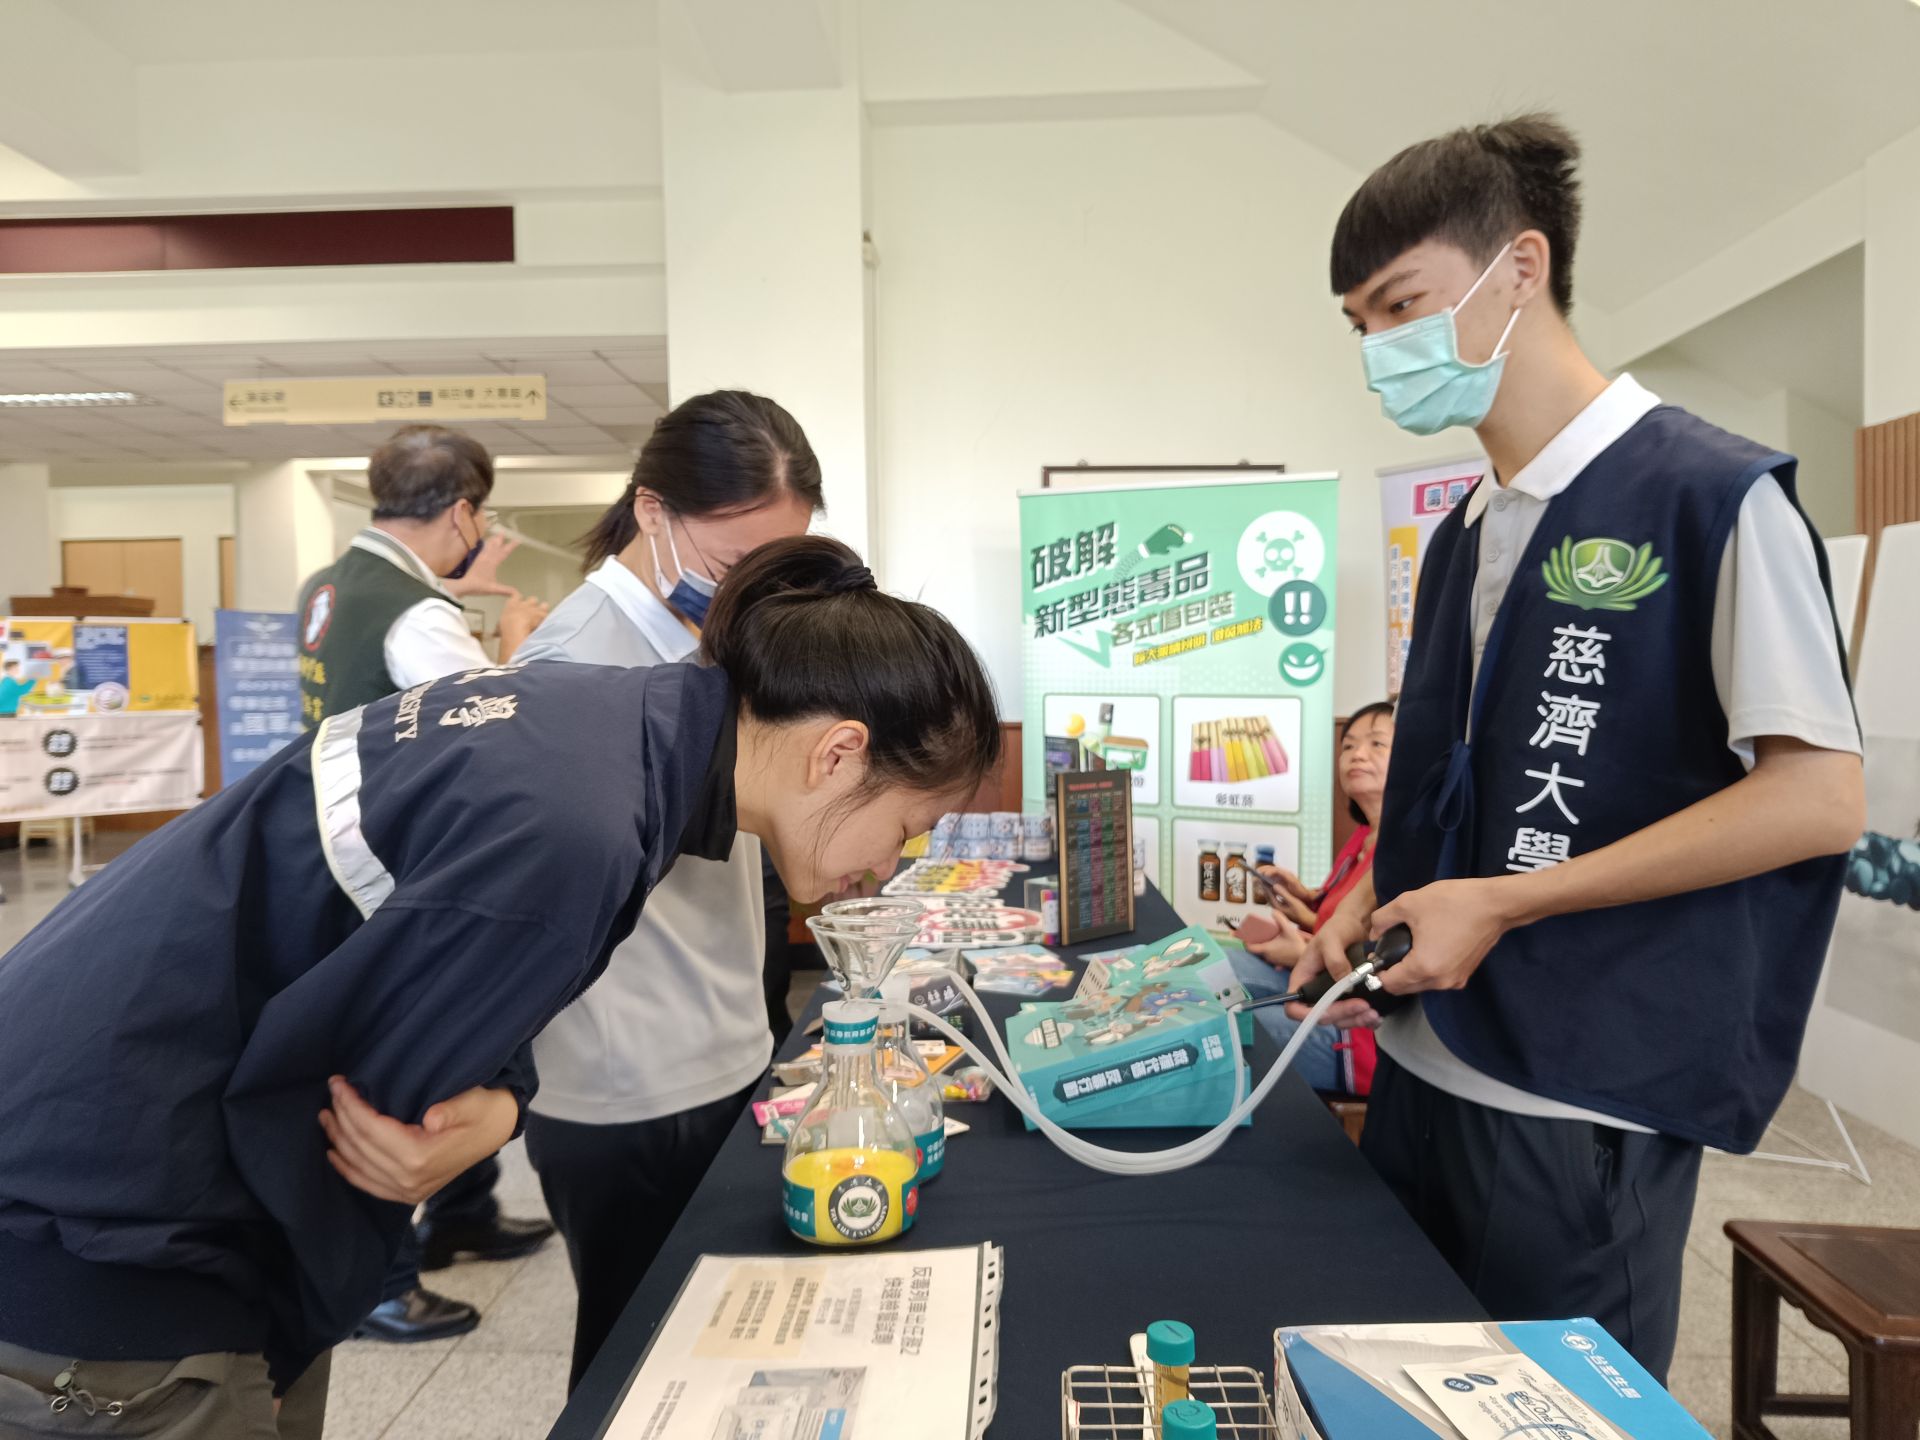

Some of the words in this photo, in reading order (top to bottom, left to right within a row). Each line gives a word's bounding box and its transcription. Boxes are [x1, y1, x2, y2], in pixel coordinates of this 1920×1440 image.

[1031, 521, 1116, 591] 破解
[1505, 621, 1612, 874] 慈濟大學
[1533, 1406, 1554, 1423] One
